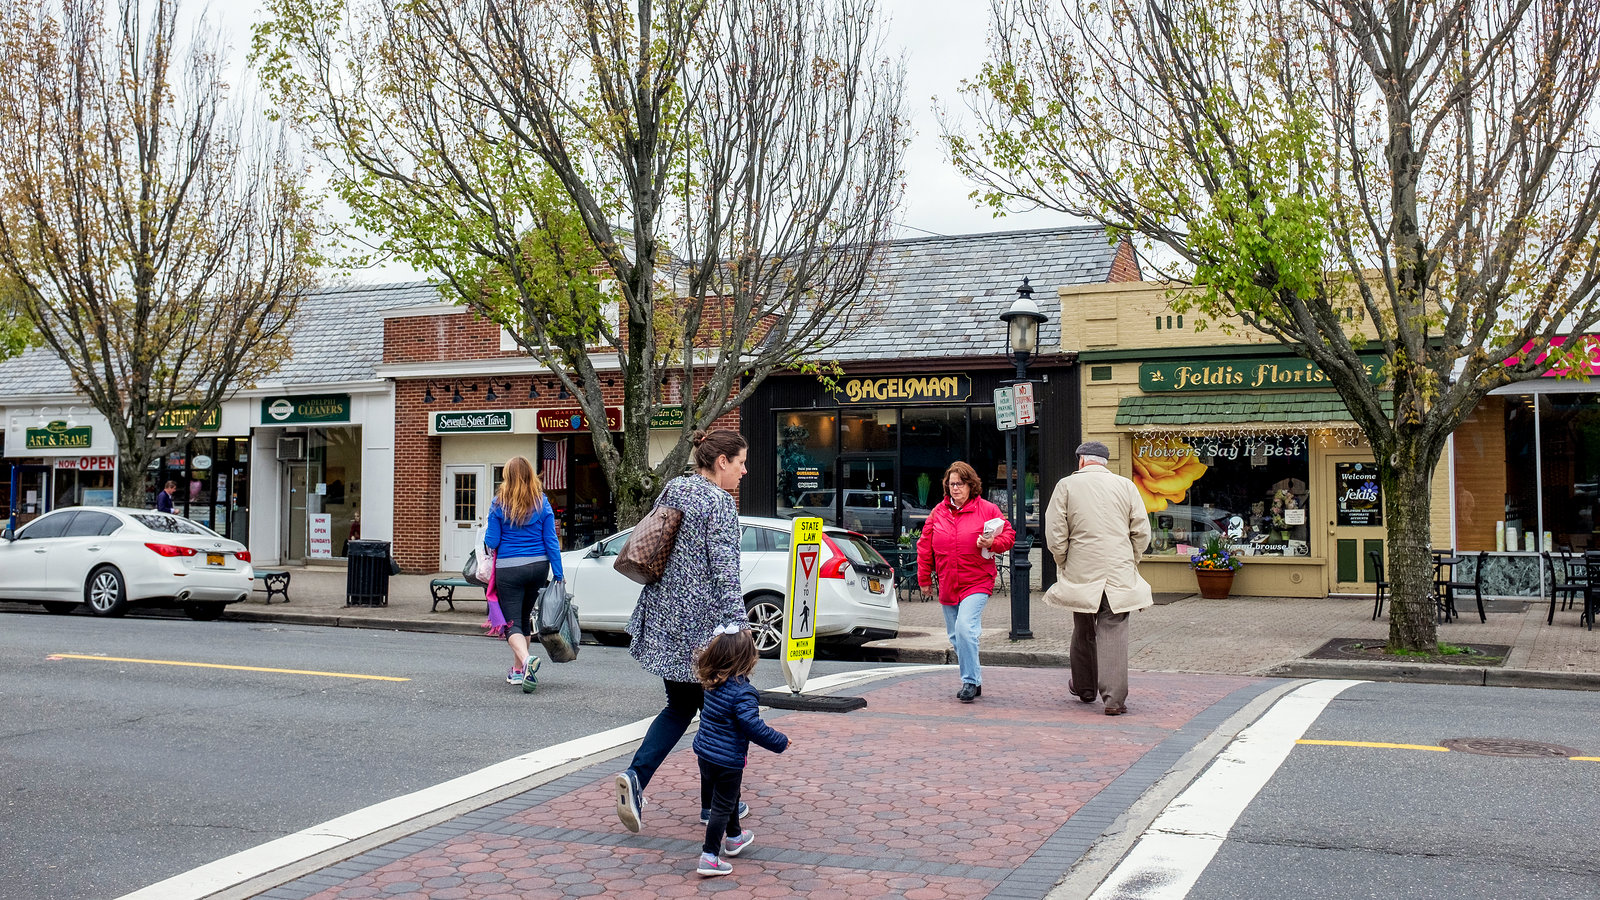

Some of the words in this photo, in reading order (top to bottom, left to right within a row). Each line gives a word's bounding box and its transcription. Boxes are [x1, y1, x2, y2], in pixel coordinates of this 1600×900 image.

[1173, 365, 1243, 389] Feldis
[1251, 363, 1332, 388] Floris
[846, 376, 958, 402] BAGELMAN
[1019, 387, 1027, 395] NO
[298, 404, 343, 415] CLEANERS
[671, 409, 683, 418] City
[440, 415, 467, 428] Seventh
[466, 415, 486, 428] Street
[485, 413, 507, 425] Travel
[540, 416, 569, 428] Wines
[29, 435, 46, 446] ART
[48, 434, 56, 446] &
[59, 433, 88, 445] FRAME
[1138, 446, 1201, 458] Flowers
[1207, 445, 1239, 460] Say
[1243, 445, 1257, 457] It
[1263, 444, 1301, 457] Best
[59, 460, 76, 468] NOW
[80, 456, 115, 470] OPEN
[1339, 487, 1377, 501] feldis
[801, 521, 819, 531] STATE
[803, 533, 816, 541] LAW
[803, 588, 810, 596] TO
[790, 649, 812, 657] CROSSWALK
